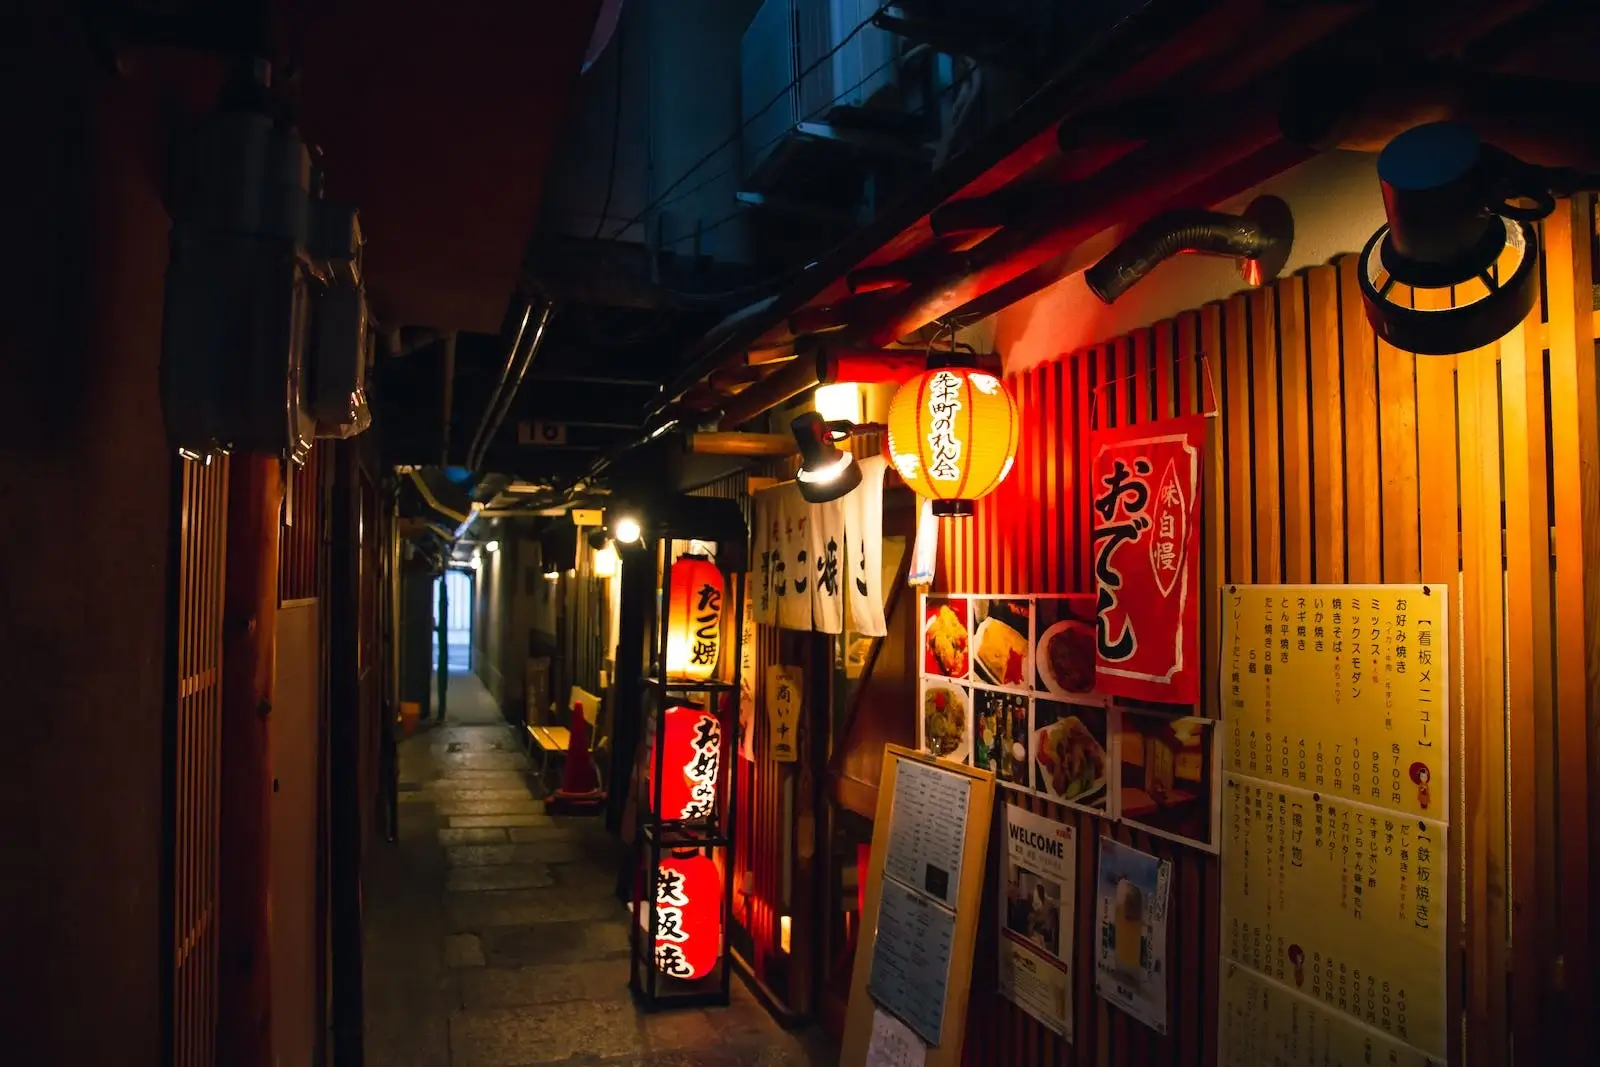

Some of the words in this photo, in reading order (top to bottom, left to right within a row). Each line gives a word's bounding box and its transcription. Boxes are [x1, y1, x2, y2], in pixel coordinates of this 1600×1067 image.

[529, 422, 558, 440] 16
[932, 373, 958, 478] 先斗町のれん会
[1153, 480, 1180, 571] 味自慢
[1095, 457, 1151, 661] おでん
[692, 583, 721, 665] たこ焼
[1231, 596, 1241, 696] プレートたこ焼き
[1280, 597, 1289, 663] とん平焼き
[1297, 597, 1306, 651] ネギ焼き
[1314, 598, 1324, 652] いか焼き
[1332, 598, 1342, 653] 焼きそば
[1351, 598, 1361, 698] ミックスモダン
[1370, 598, 1380, 656] ミックス
[1395, 599, 1407, 674] お好み焼き
[1248, 650, 1256, 674] 5個
[1417, 619, 1432, 747] 【看板メニュー】
[776, 686, 791, 737] 商い中
[1265, 733, 1273, 774] 600円
[1281, 736, 1289, 778] 400円
[1316, 742, 1324, 785] 180円
[1334, 744, 1342, 789] 700円
[1352, 736, 1361, 795] 1000円
[1371, 751, 1380, 798] 950円
[1391, 743, 1401, 804] 各700円
[1009, 821, 1064, 859] WELCOME
[1341, 811, 1350, 865] イカバター
[1368, 817, 1378, 888] 牛すじポン酢
[1415, 835, 1431, 928] 【鉄板焼き】
